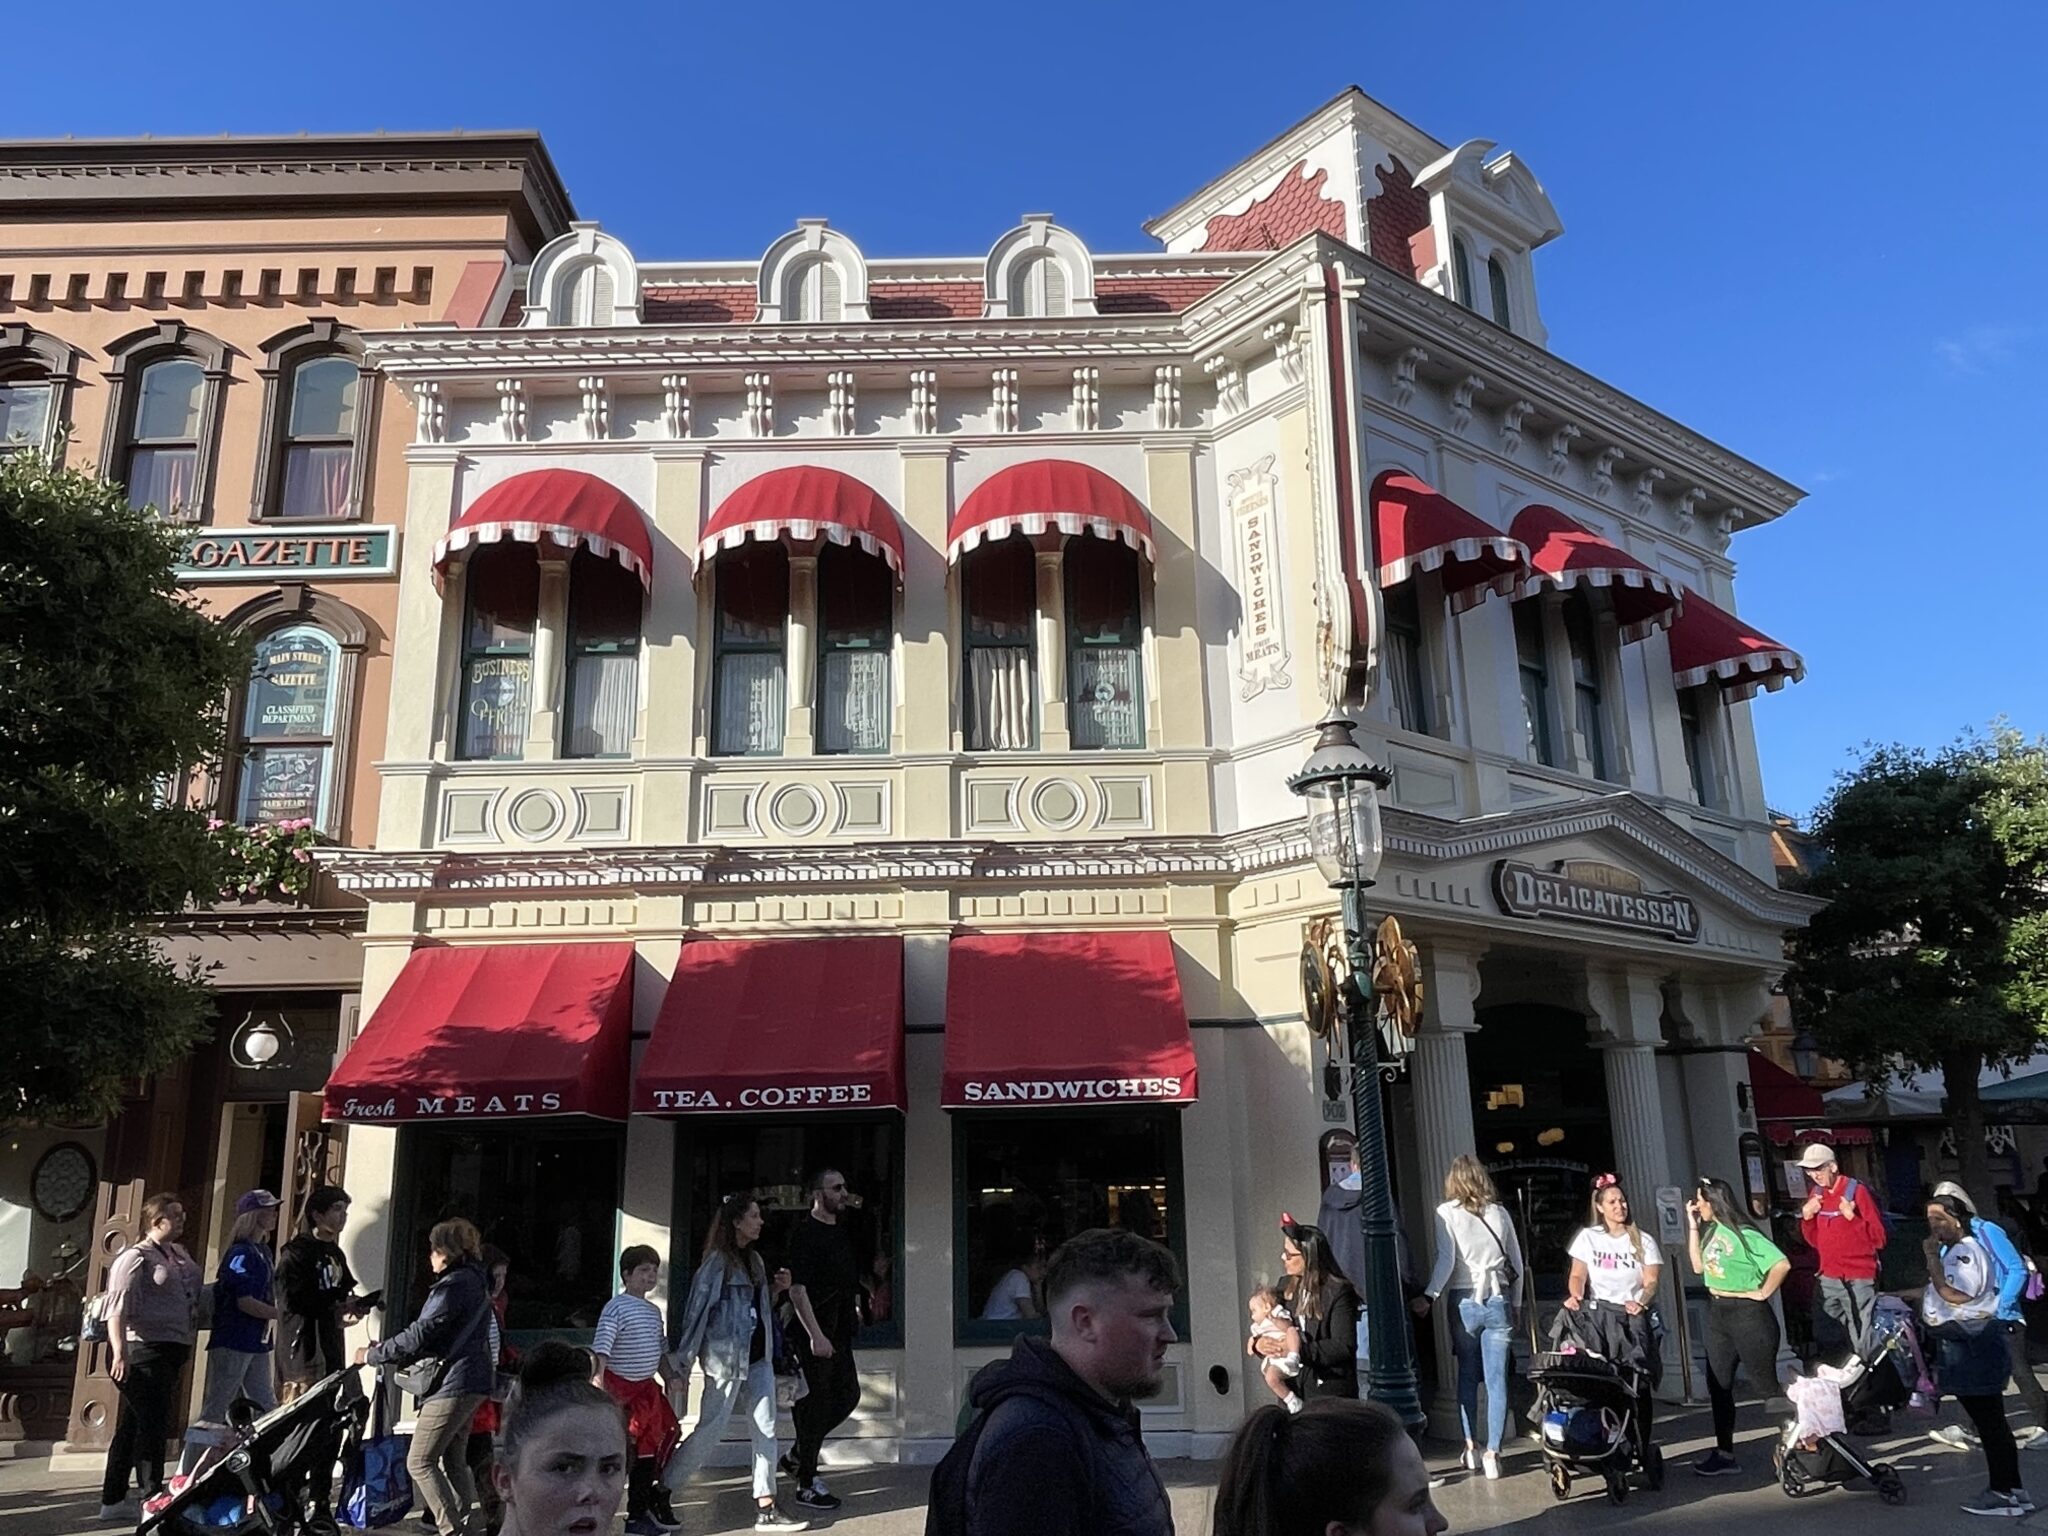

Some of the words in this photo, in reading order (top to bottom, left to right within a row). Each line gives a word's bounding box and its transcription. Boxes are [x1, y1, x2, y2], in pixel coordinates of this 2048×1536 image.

[192, 537, 370, 568] GAZETTE
[1248, 516, 1267, 636] SANDWICHES
[269, 652, 291, 665] MAIN
[292, 651, 323, 664] STREET
[1246, 642, 1280, 663] MEATS
[472, 659, 530, 683] BUSINESS
[262, 714, 317, 724] DEPARTMENT
[266, 705, 315, 715] CLASSIFIED
[1513, 871, 1692, 932] DELICATESSEN
[739, 1084, 871, 1107] COFFEE
[964, 1077, 1182, 1101] SANDWICHES
[342, 1098, 396, 1117] Fresh
[416, 1093, 561, 1115] MEATS
